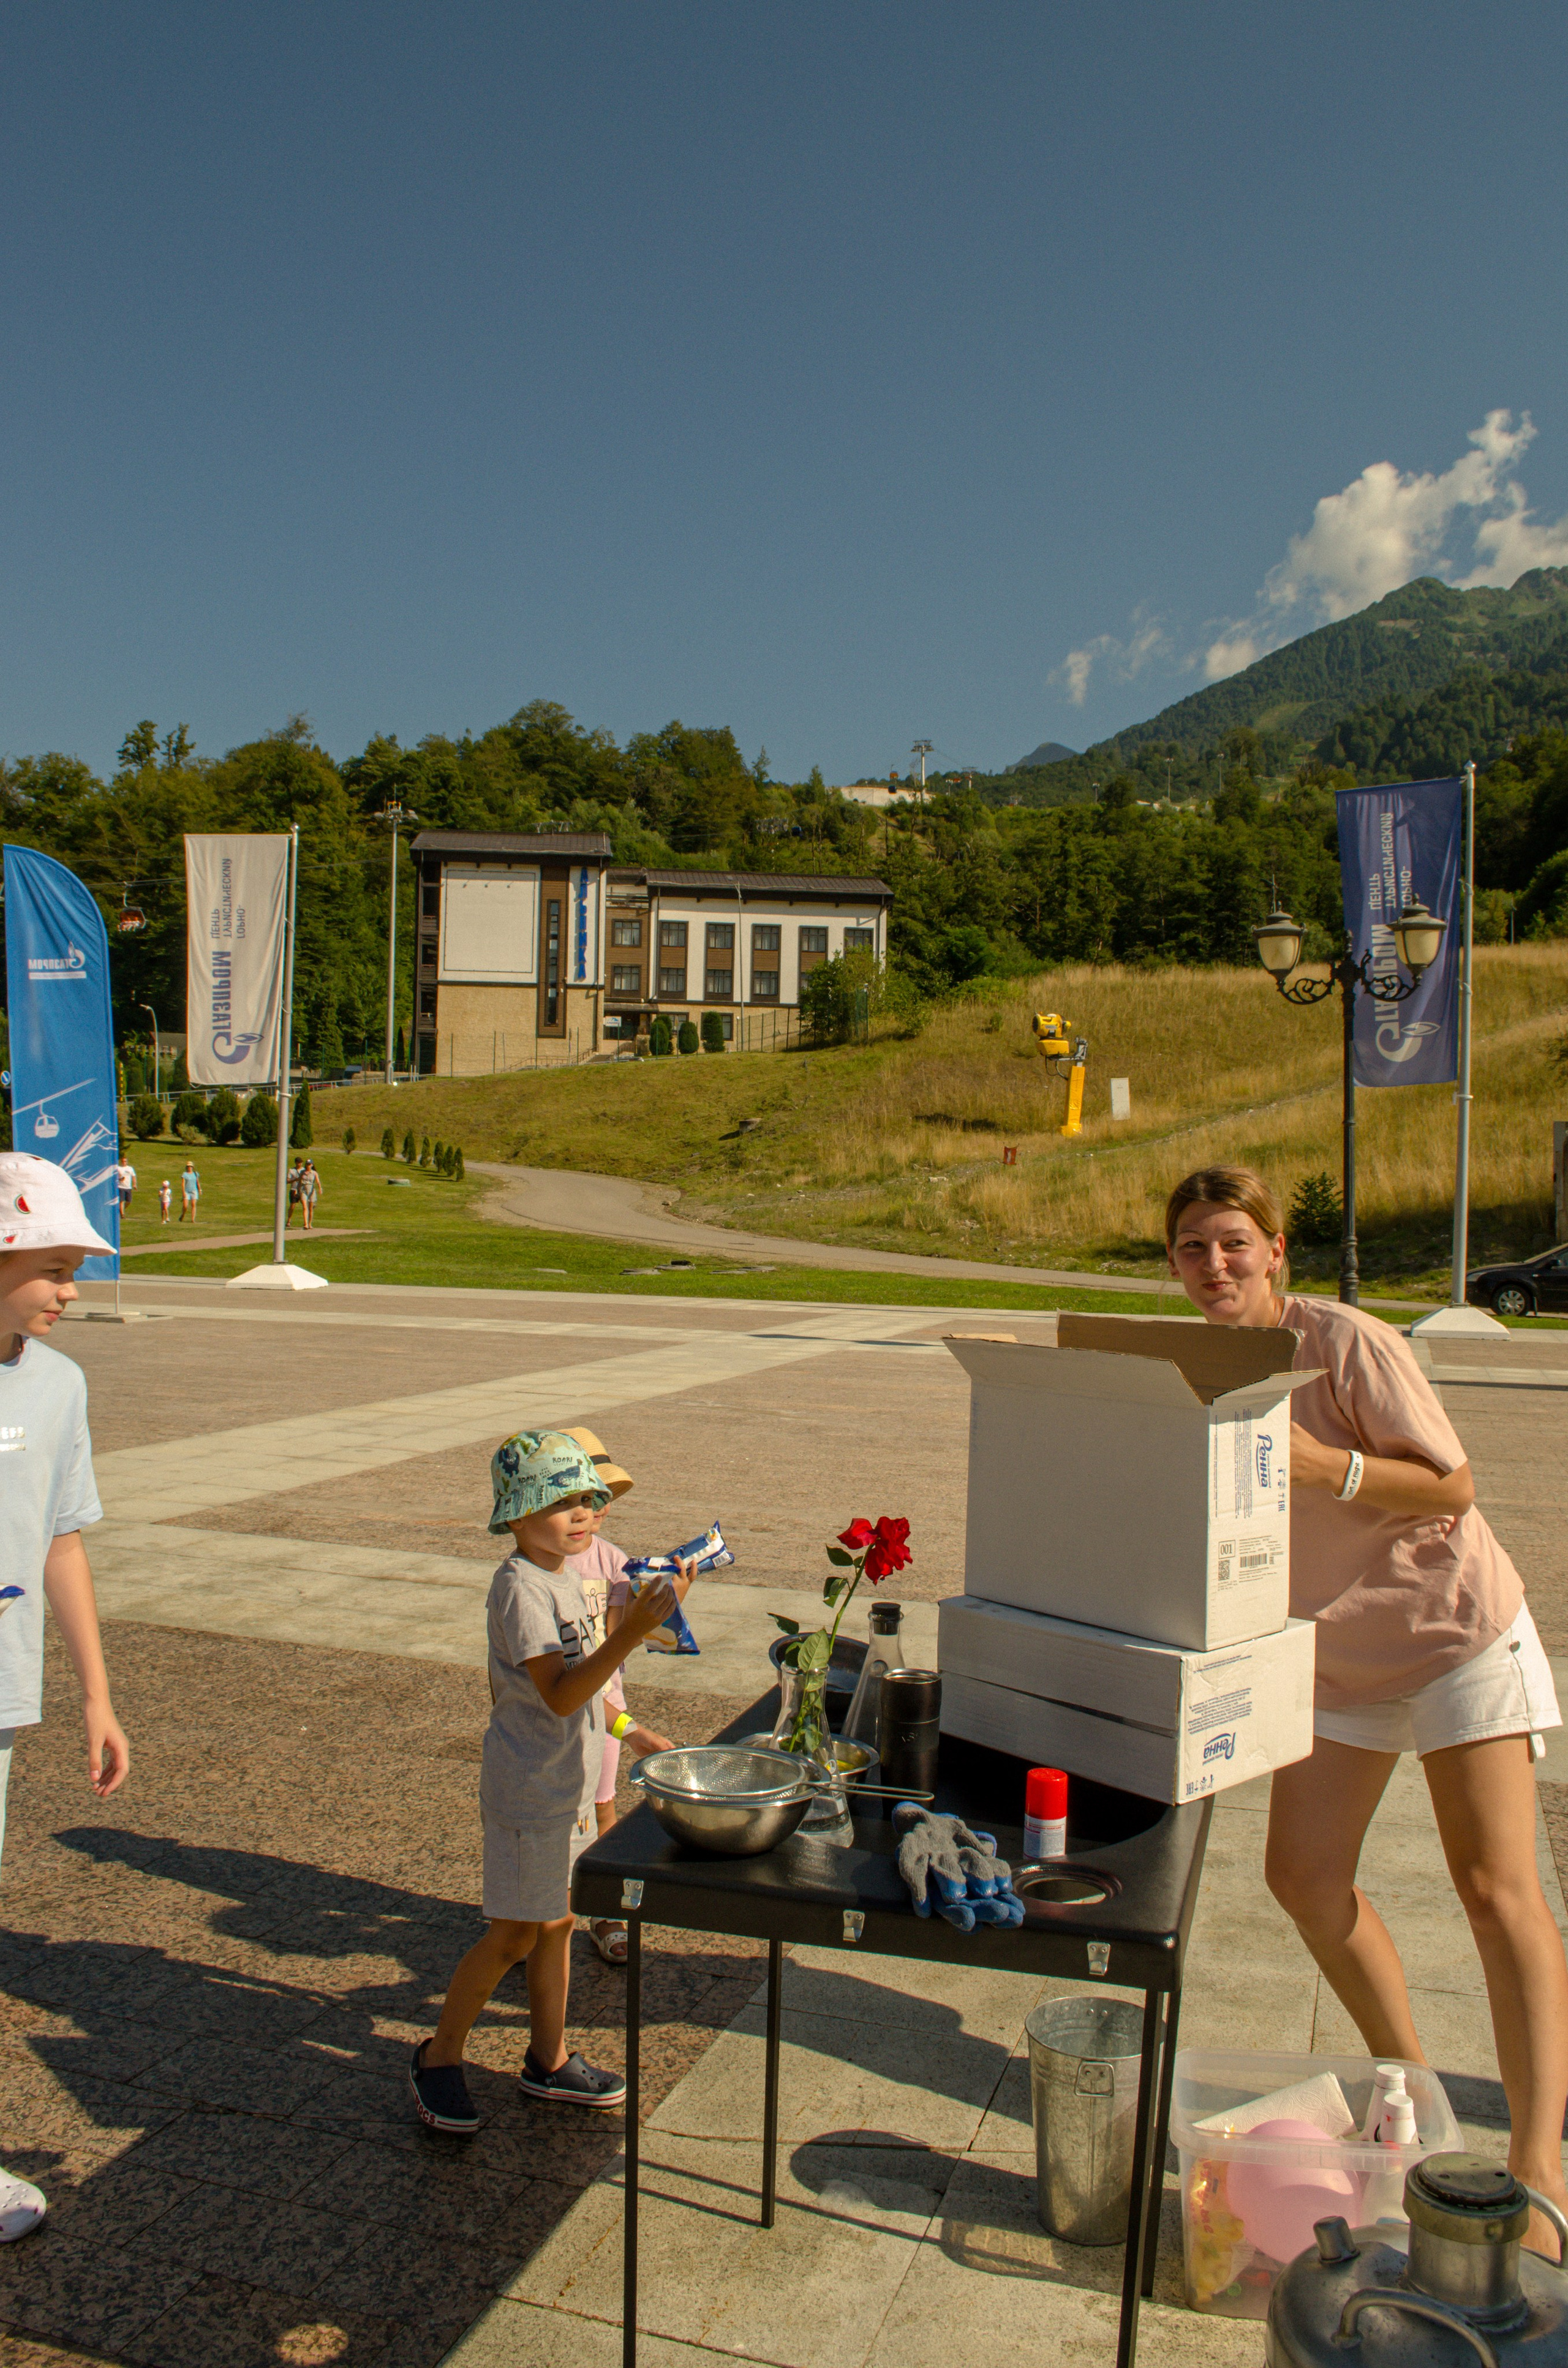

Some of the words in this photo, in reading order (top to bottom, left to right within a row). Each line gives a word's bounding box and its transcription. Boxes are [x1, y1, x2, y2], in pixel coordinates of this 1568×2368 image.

[578, 867, 589, 978] АЛЬПИКА
[1256, 1434, 1273, 1488] Ренна
[1221, 1544, 1232, 1555] 001
[1204, 1732, 1236, 1760] Ренна
